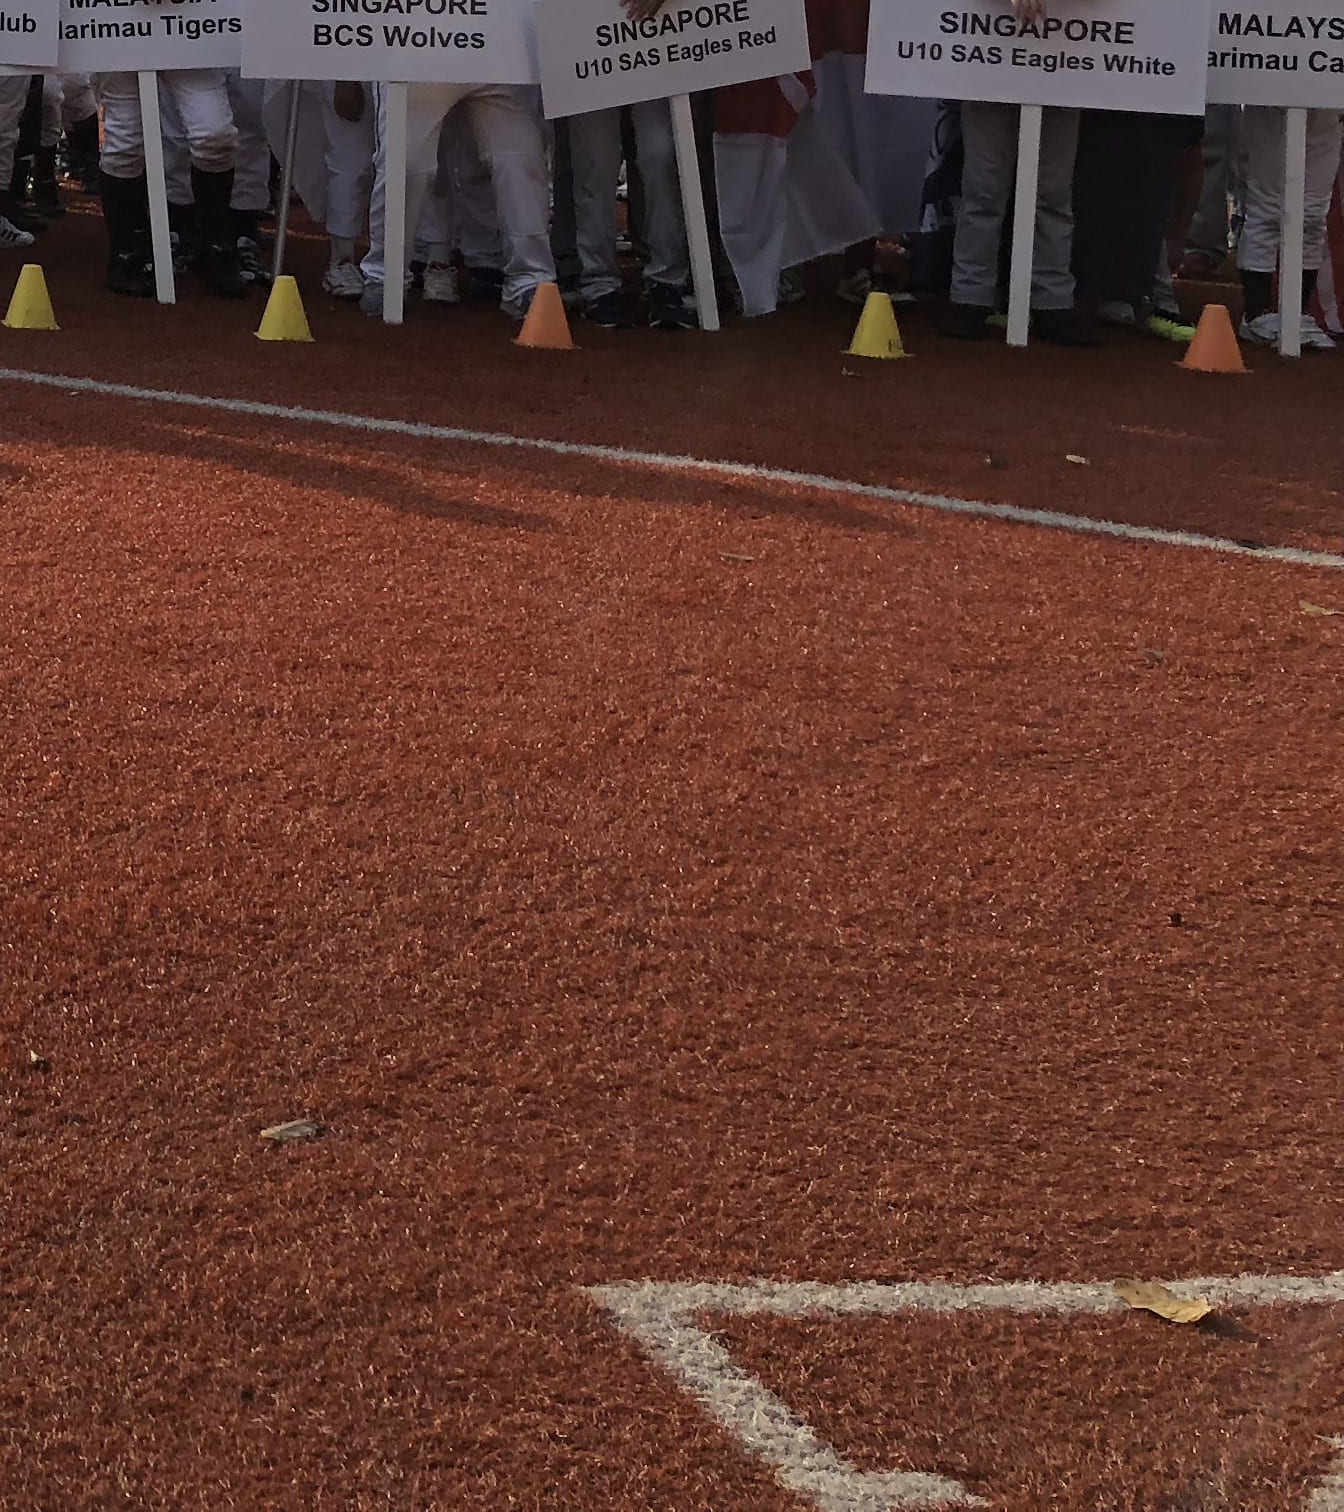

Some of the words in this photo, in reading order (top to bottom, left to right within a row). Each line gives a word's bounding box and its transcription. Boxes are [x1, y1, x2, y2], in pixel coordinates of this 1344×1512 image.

[160, 14, 243, 40] Tigers
[312, 23, 374, 47] BCS
[383, 24, 485, 50] Wolves
[939, 11, 1135, 45] SINGAPORE
[1218, 12, 1344, 41] MALAYS
[575, 56, 613, 79] U10
[618, 48, 661, 72] SAS
[667, 37, 733, 64] Eagles
[739, 25, 777, 50] Red
[897, 41, 942, 63] U10
[951, 44, 1003, 66] SAS
[1011, 46, 1095, 72] Eagles
[1104, 53, 1177, 77] White
[1208, 46, 1298, 72] arimau
